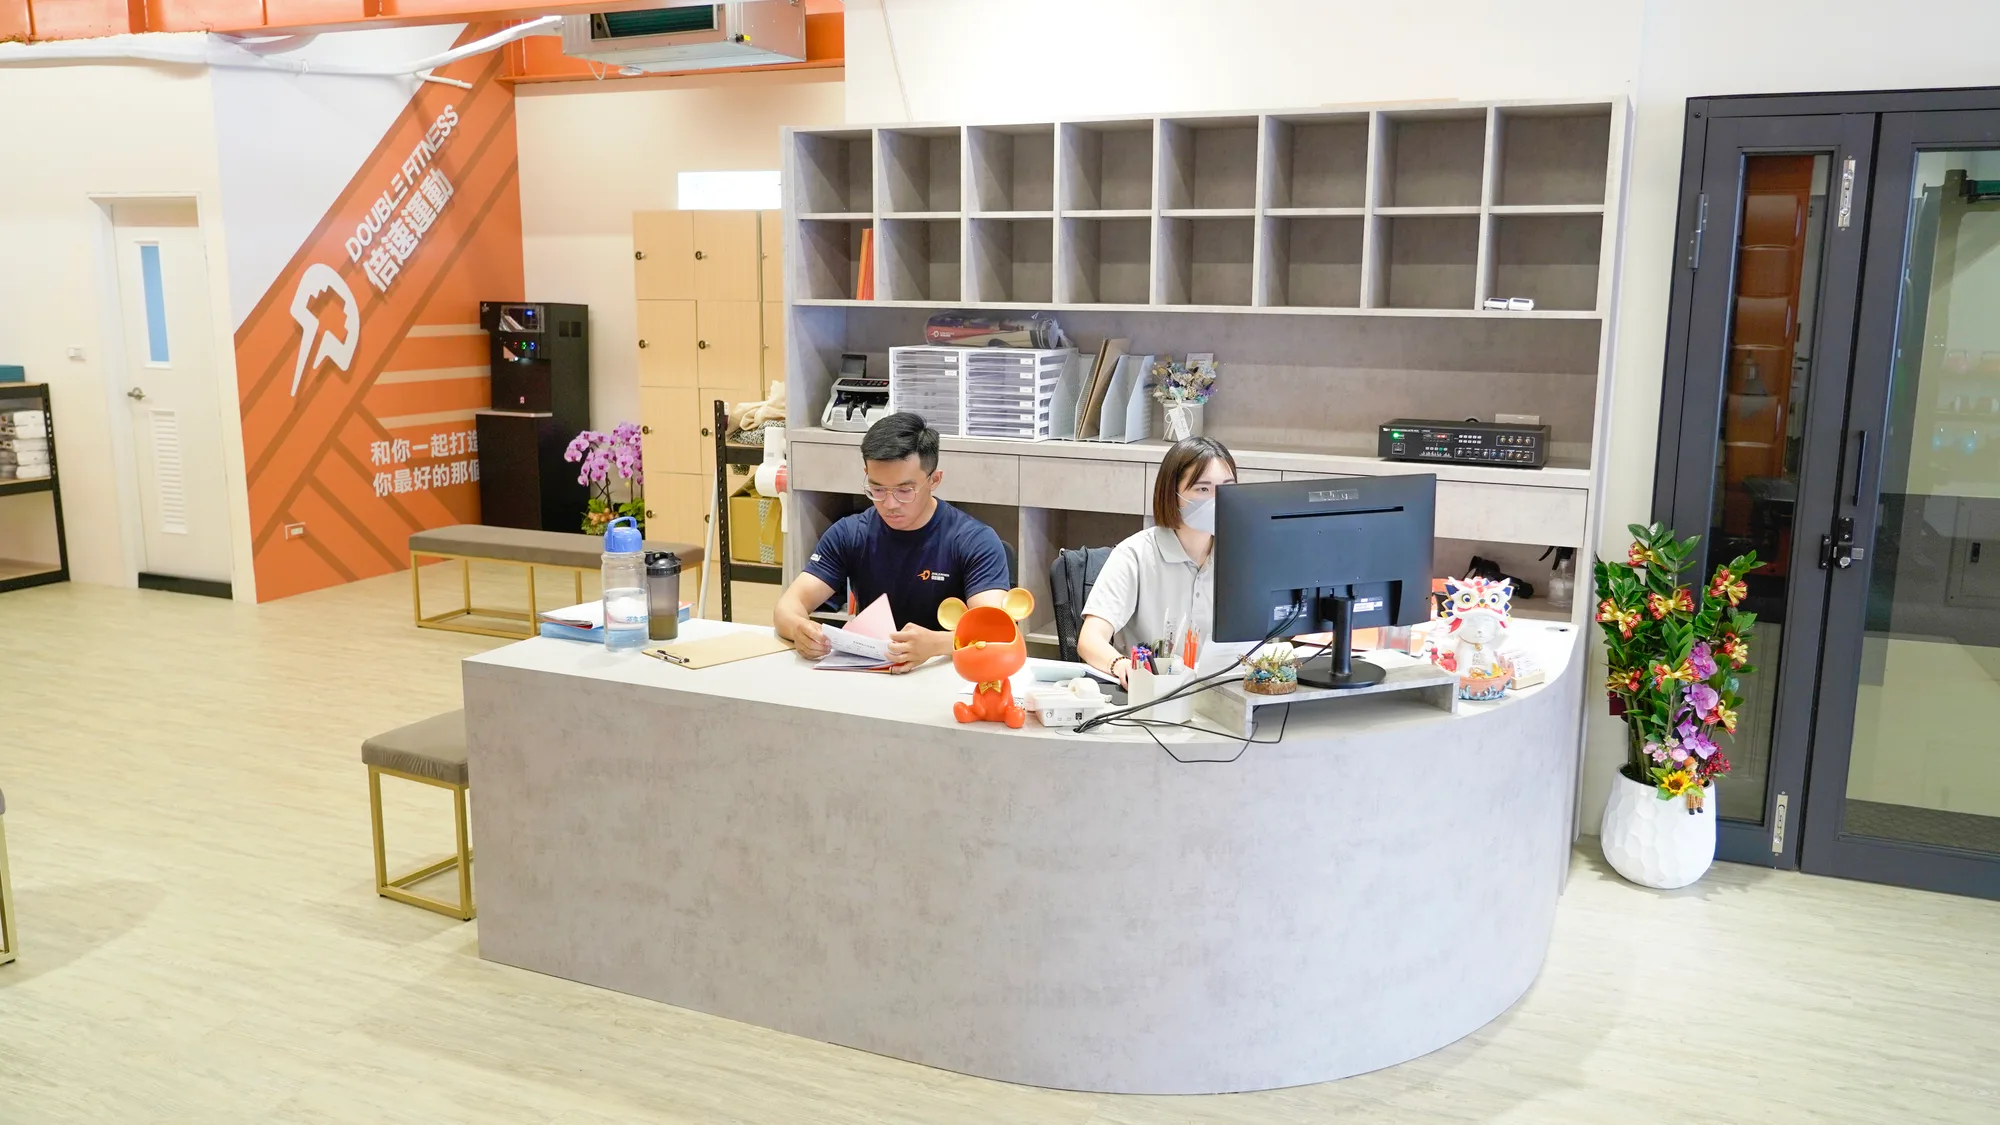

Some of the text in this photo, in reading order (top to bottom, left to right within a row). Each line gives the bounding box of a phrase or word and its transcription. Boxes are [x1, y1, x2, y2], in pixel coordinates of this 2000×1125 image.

[345, 104, 459, 263] DOUBLE FITNESS
[362, 168, 454, 292] 倍速運動
